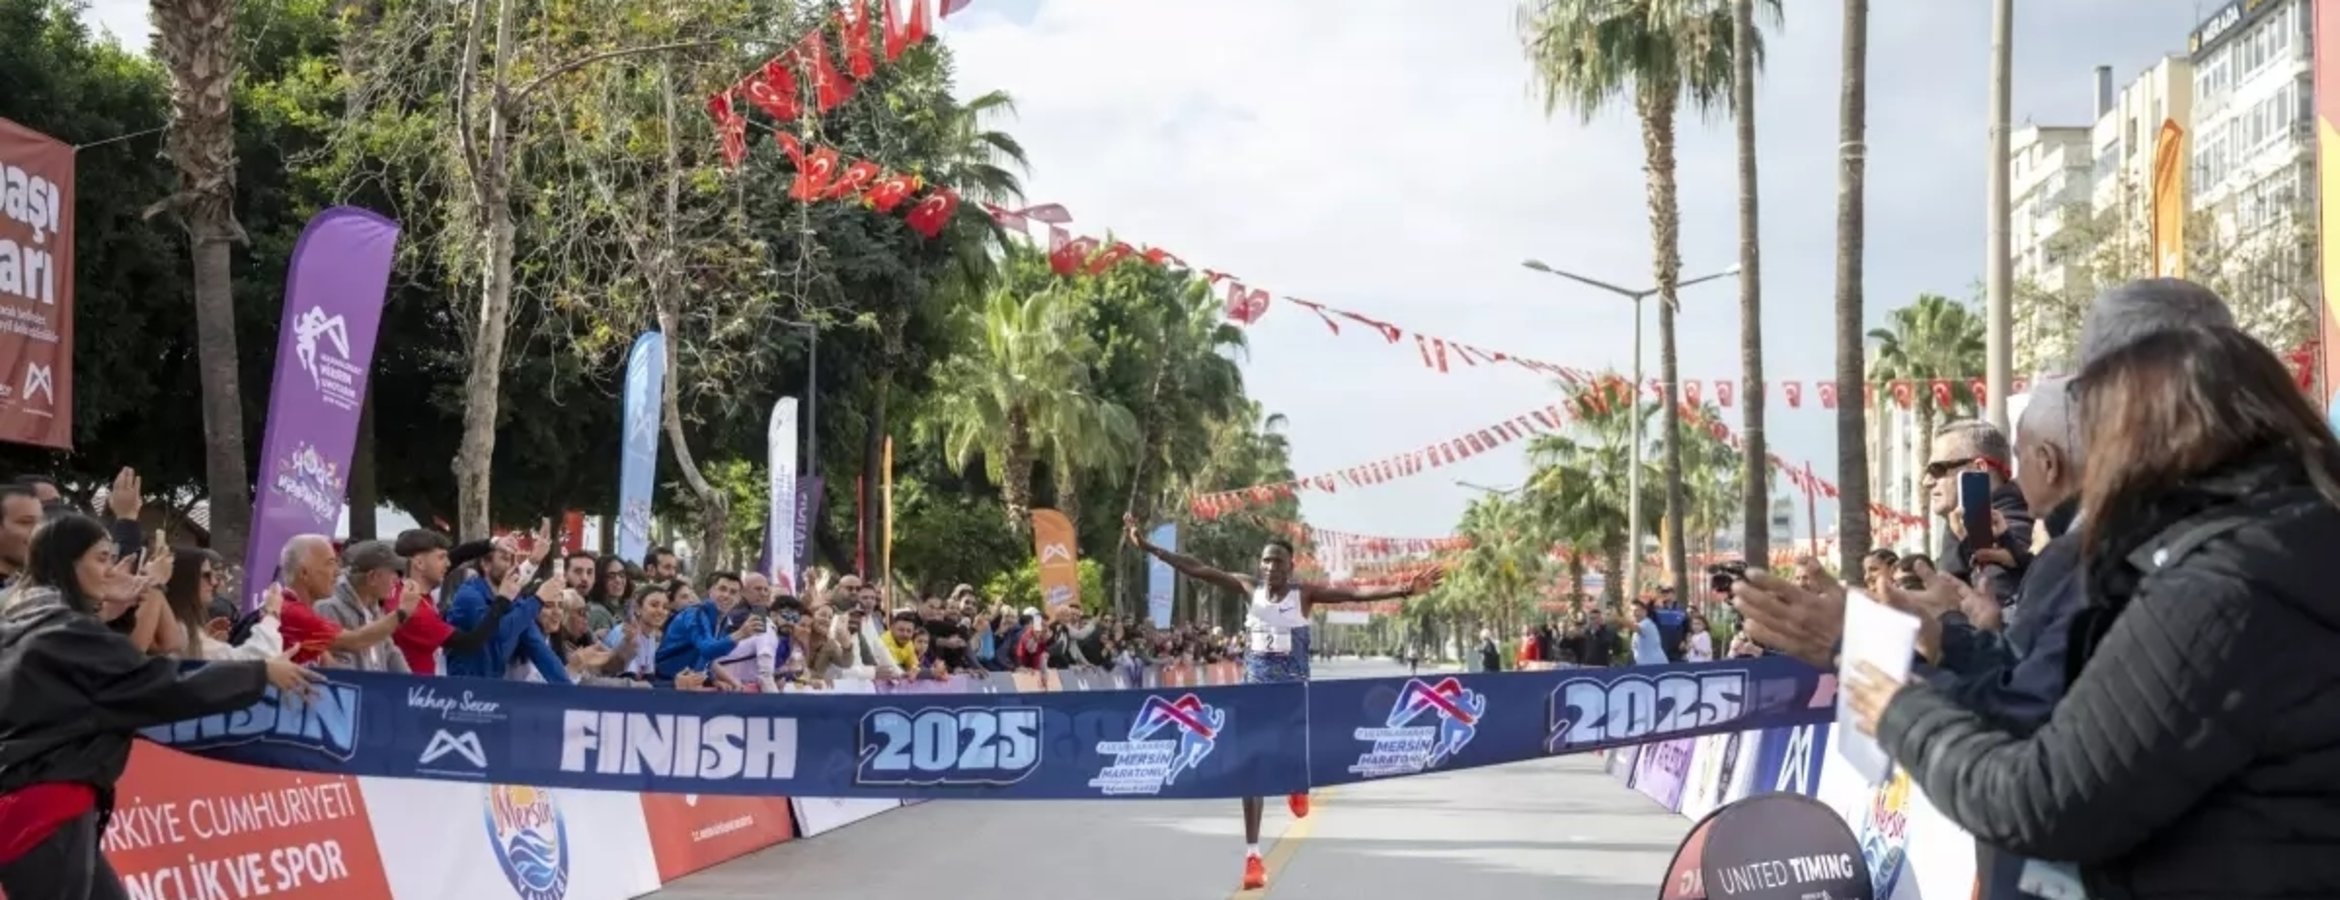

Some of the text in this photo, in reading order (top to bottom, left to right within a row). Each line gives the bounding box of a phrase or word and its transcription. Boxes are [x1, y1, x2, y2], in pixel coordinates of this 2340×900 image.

[0, 162, 60, 243] aşı
[1265, 634, 1275, 651] 2
[408, 685, 457, 719] Vahap
[1560, 674, 1743, 744] 2025
[560, 709, 798, 779] FINISH
[869, 711, 1038, 776] 2025
[1117, 752, 1172, 766] MERSİN
[101, 774, 356, 852] RKİYE CUMHURİYETİ
[119, 840, 349, 900] NCLİK VE SPOR
[1717, 853, 1855, 895] UNITED TIMING
